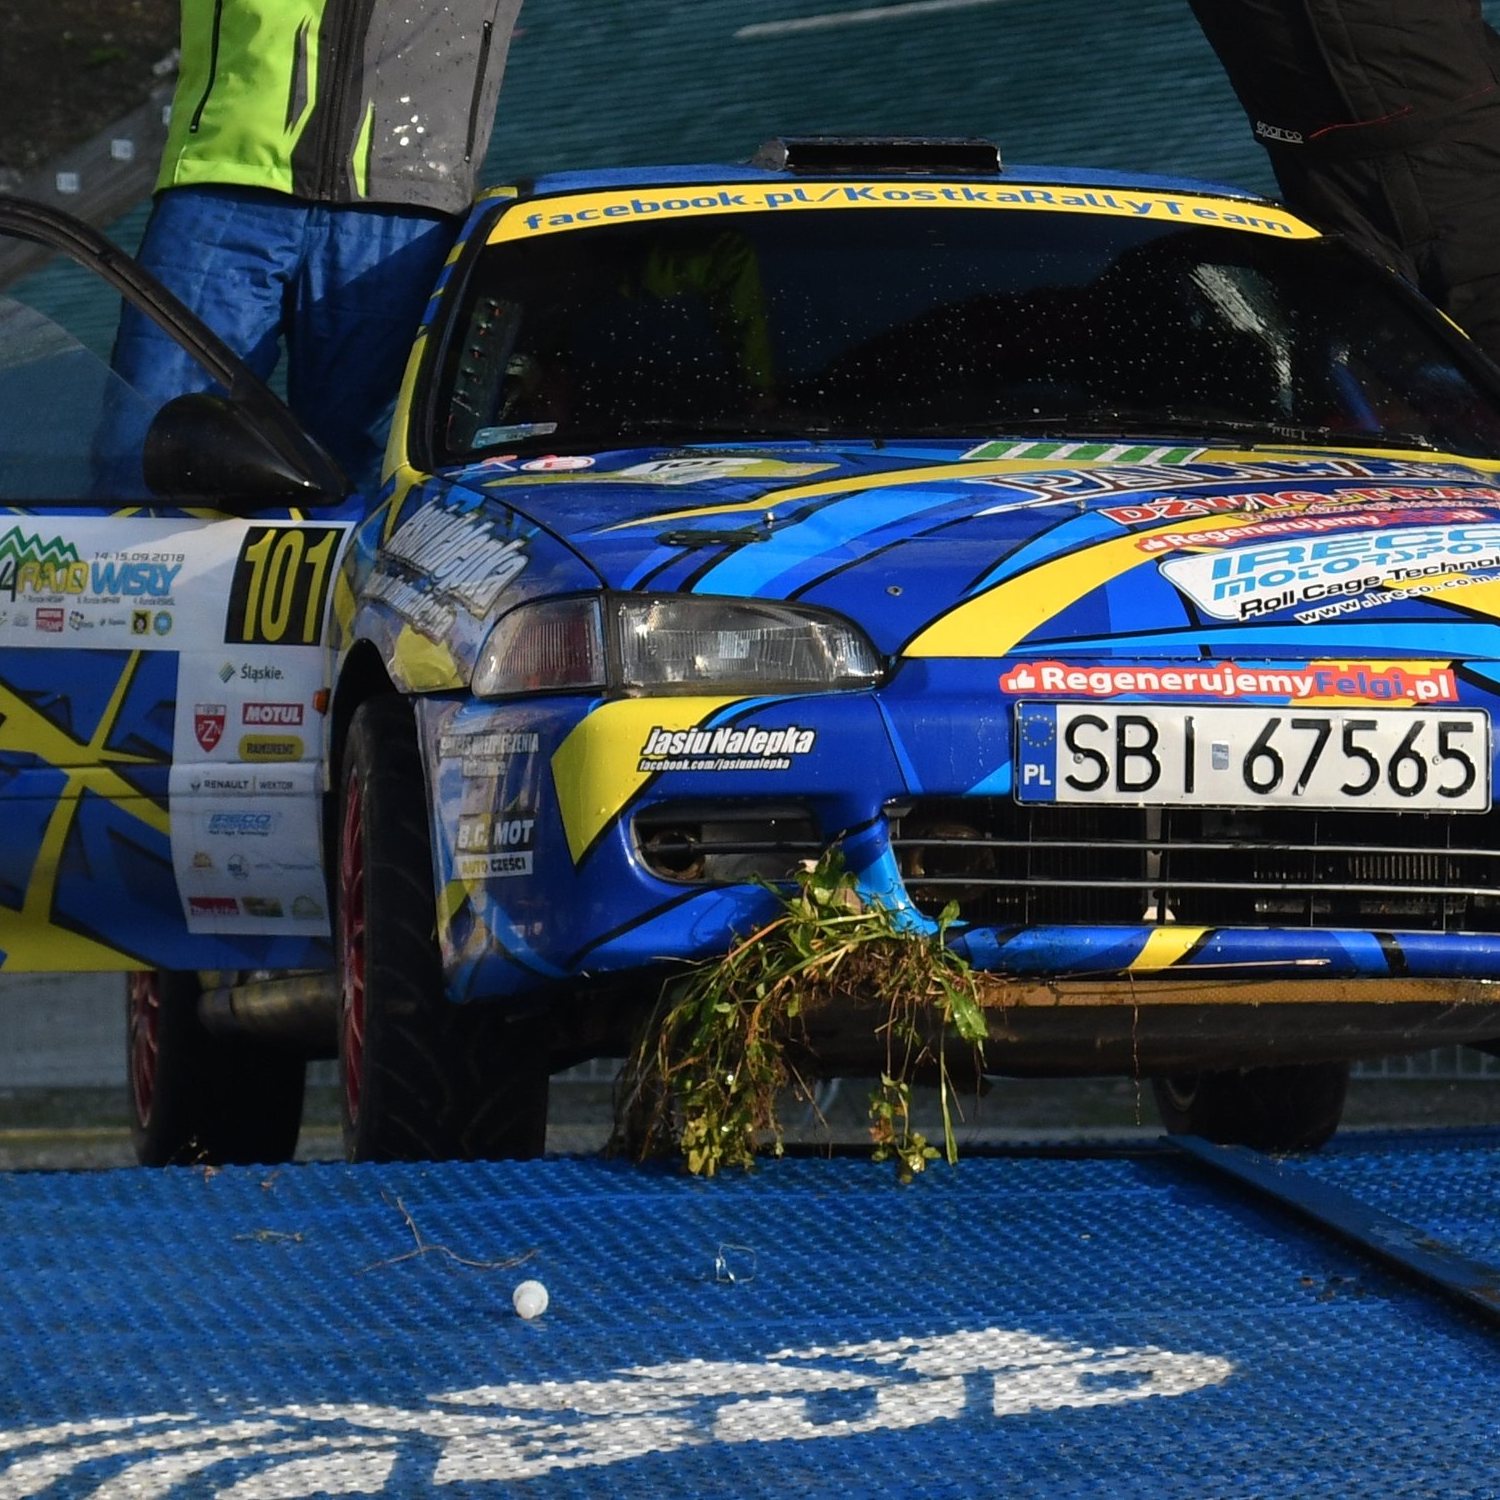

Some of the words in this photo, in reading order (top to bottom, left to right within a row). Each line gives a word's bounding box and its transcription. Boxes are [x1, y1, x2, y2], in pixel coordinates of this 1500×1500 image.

[522, 185, 1294, 235] facebook.pl/KostkaRallyTeam
[94, 551, 185, 563] 14-15.09.2018
[242, 528, 339, 644] 101
[1239, 583, 1298, 621] Roll
[1302, 574, 1381, 601] Cage
[1040, 666, 1451, 700] RegenerujemyFelgi.pl
[244, 706, 301, 722] MOTUL
[639, 758, 791, 771] facebook.com/jasiunalepka
[1023, 764, 1051, 786] PL
[1064, 713, 1196, 794] SBI
[1242, 717, 1477, 799] 67565
[203, 780, 250, 789] RENAULT
[493, 819, 535, 846] MOT
